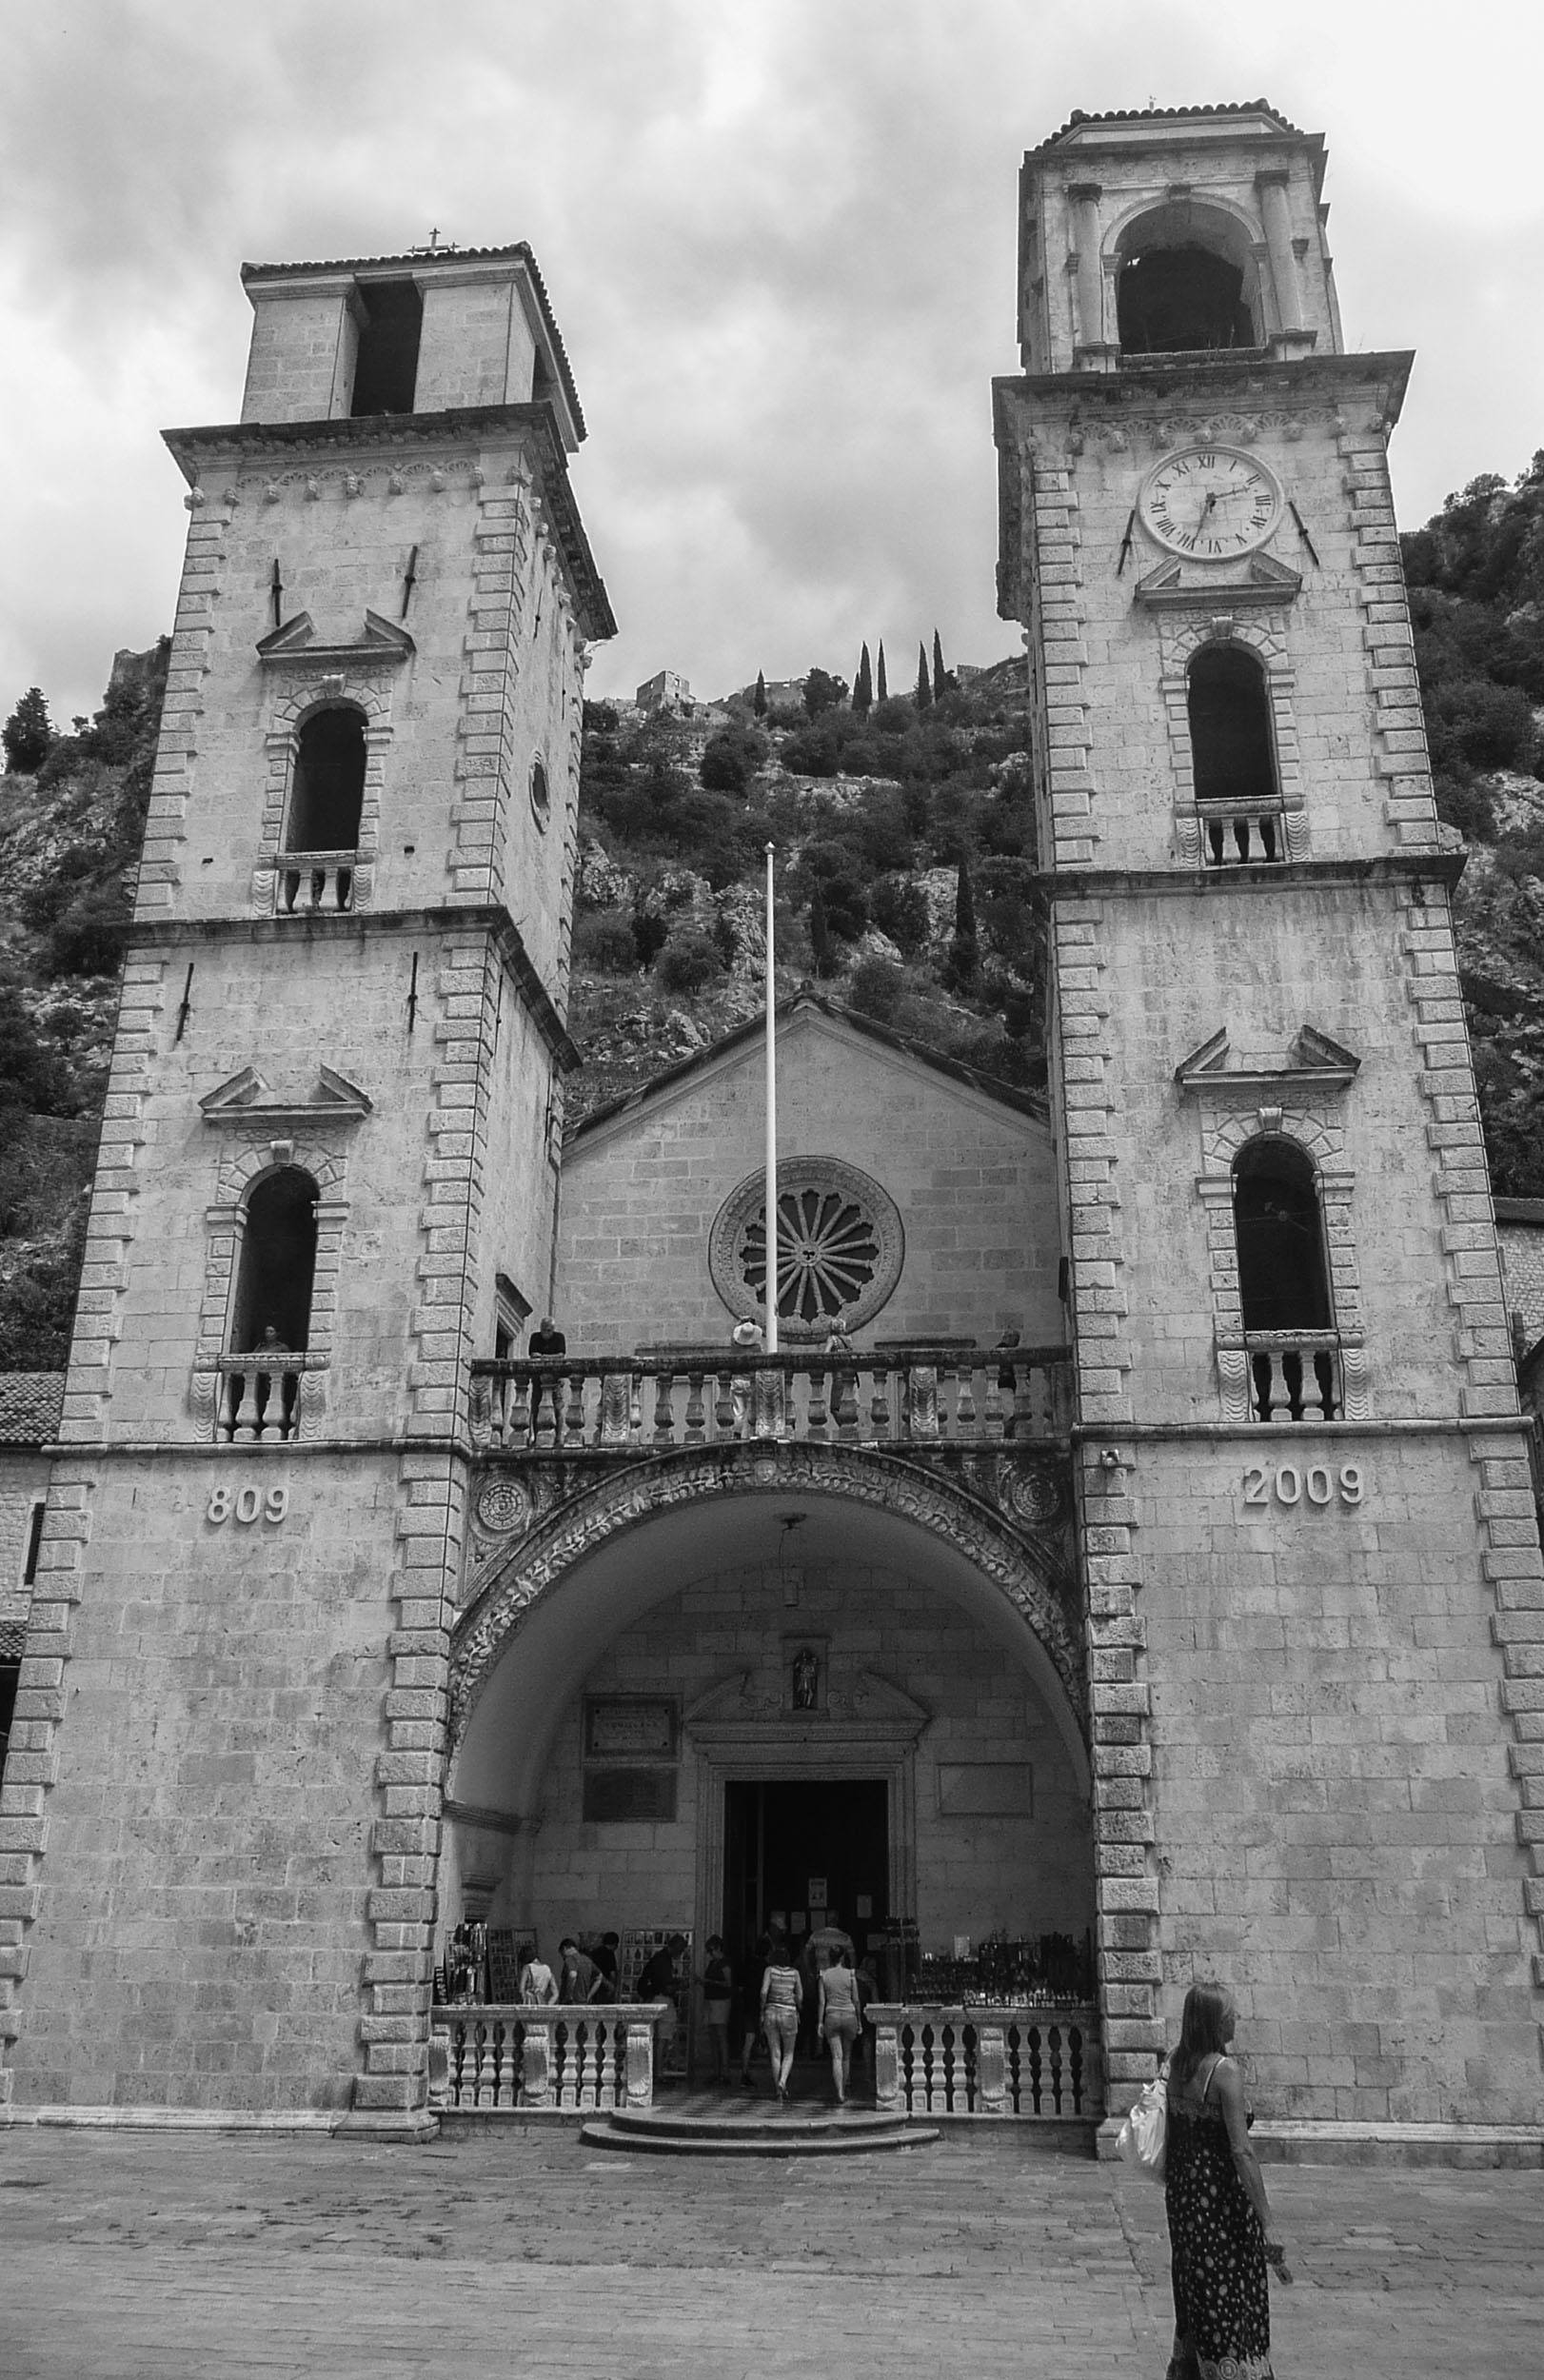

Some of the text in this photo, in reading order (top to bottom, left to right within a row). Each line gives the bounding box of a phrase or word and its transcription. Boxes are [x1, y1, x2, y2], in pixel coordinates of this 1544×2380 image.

[1172, 460, 1190, 477] XI
[1198, 455, 1215, 469] XII
[1229, 460, 1237, 472] I
[1155, 480, 1171, 491] X
[1246, 474, 1261, 486] II
[1255, 494, 1272, 506] III
[1150, 502, 1166, 513] IX
[1156, 518, 1177, 538] VIII
[1250, 515, 1268, 529] IV
[1177, 533, 1196, 551] VII
[1235, 533, 1247, 546] V
[1208, 540, 1222, 553] VI
[1242, 1465, 1364, 1503] 2009
[208, 1485, 289, 1522] 809
